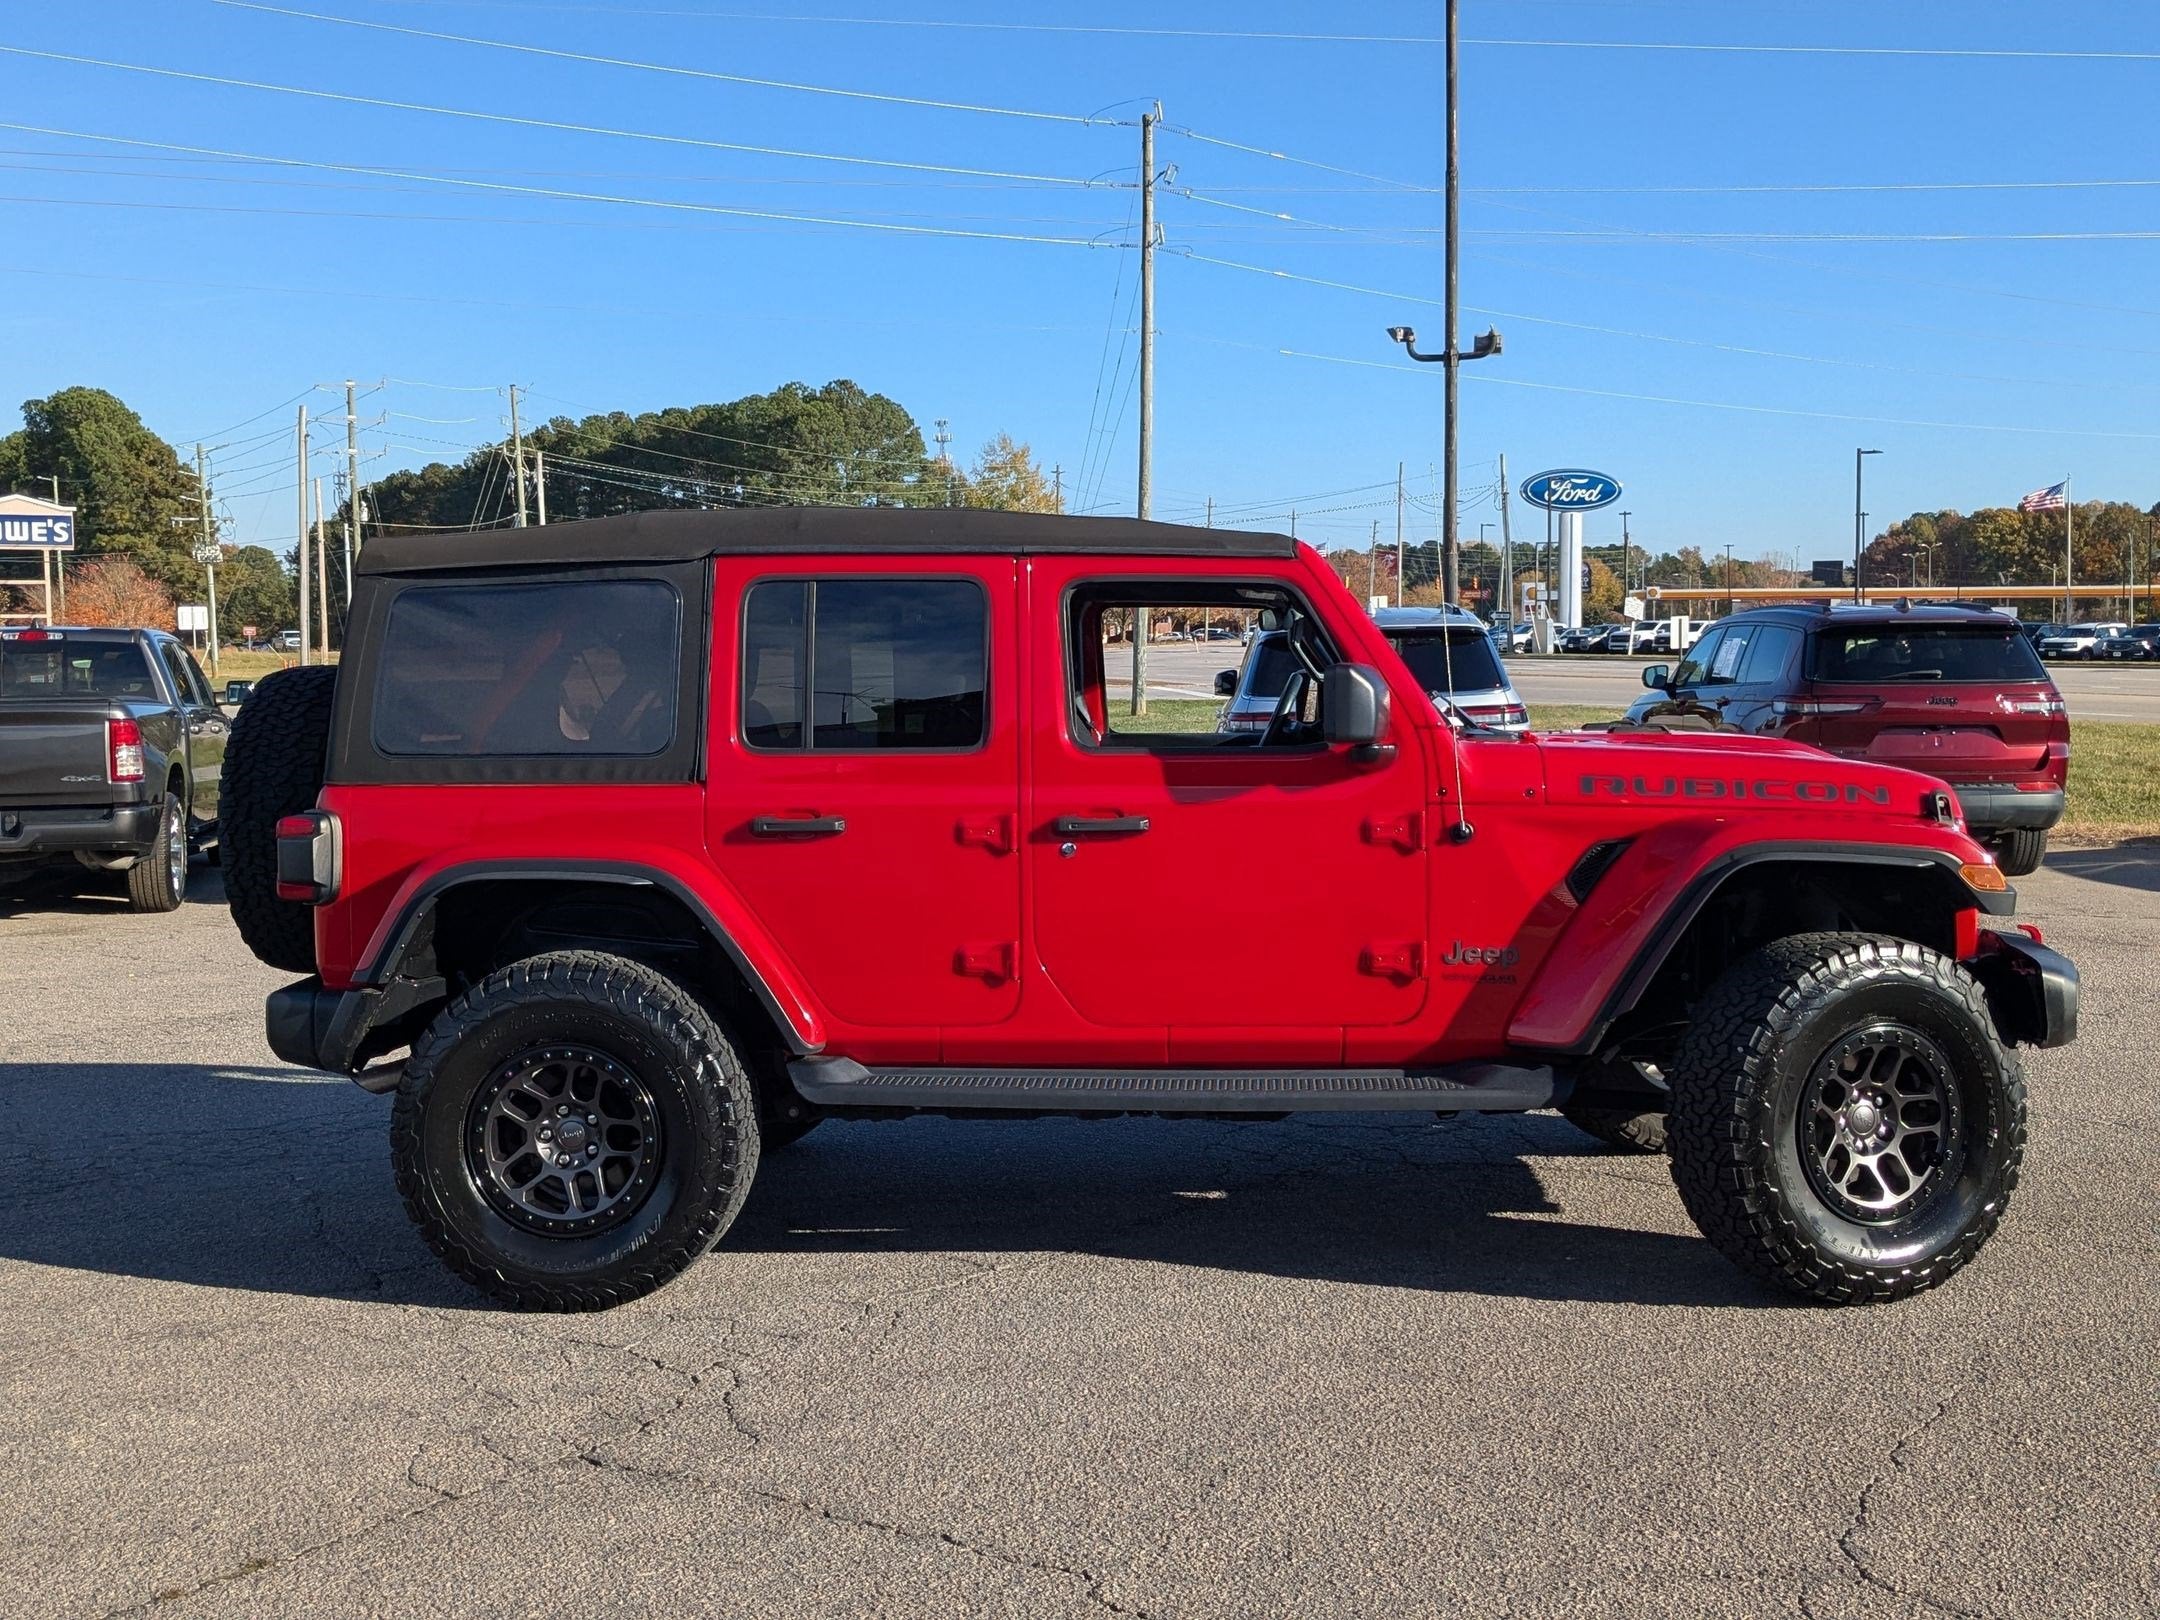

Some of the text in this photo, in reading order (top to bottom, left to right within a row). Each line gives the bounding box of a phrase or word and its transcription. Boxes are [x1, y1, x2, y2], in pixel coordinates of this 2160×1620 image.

[1544, 477, 1604, 502] Ford
[0, 519, 69, 543] WE'S
[1580, 775, 1890, 804] RUBICON
[1442, 938, 1520, 969] Jeep
